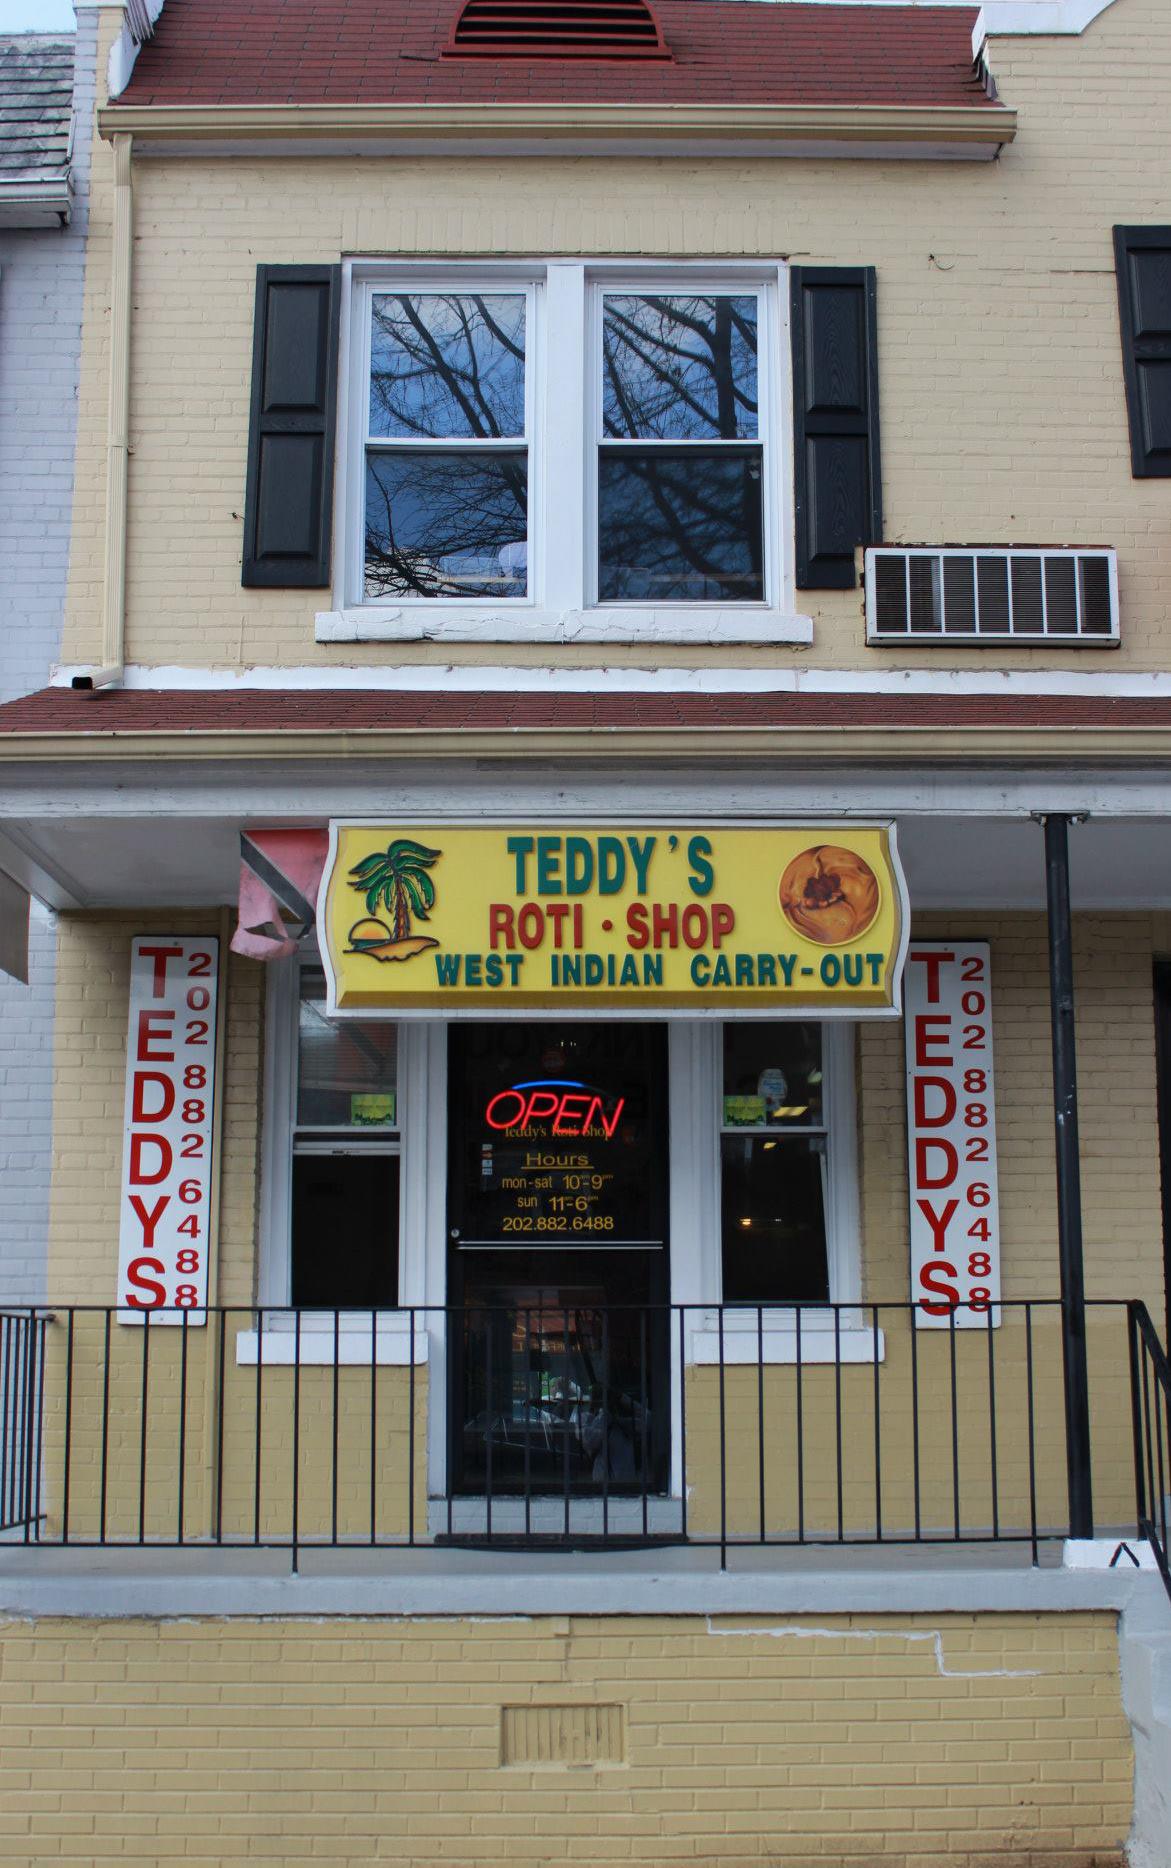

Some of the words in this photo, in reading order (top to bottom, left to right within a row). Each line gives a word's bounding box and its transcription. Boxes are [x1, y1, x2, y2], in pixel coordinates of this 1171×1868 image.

[507, 834, 715, 897] TEDDY'S
[489, 902, 583, 949] ROTI
[626, 902, 735, 949] SHOP
[434, 953, 524, 987] WEST
[551, 953, 663, 987] INDIAN
[690, 953, 884, 987] CARRY-OUT
[125, 946, 183, 1310] TEDDYS
[486, 1090, 625, 1137] OPEN
[910, 952, 960, 1316] TEDDYS
[526, 1152, 589, 1166] Hours
[502, 1216, 614, 1231] 202.882.6488
[517, 1196, 538, 1207] sun
